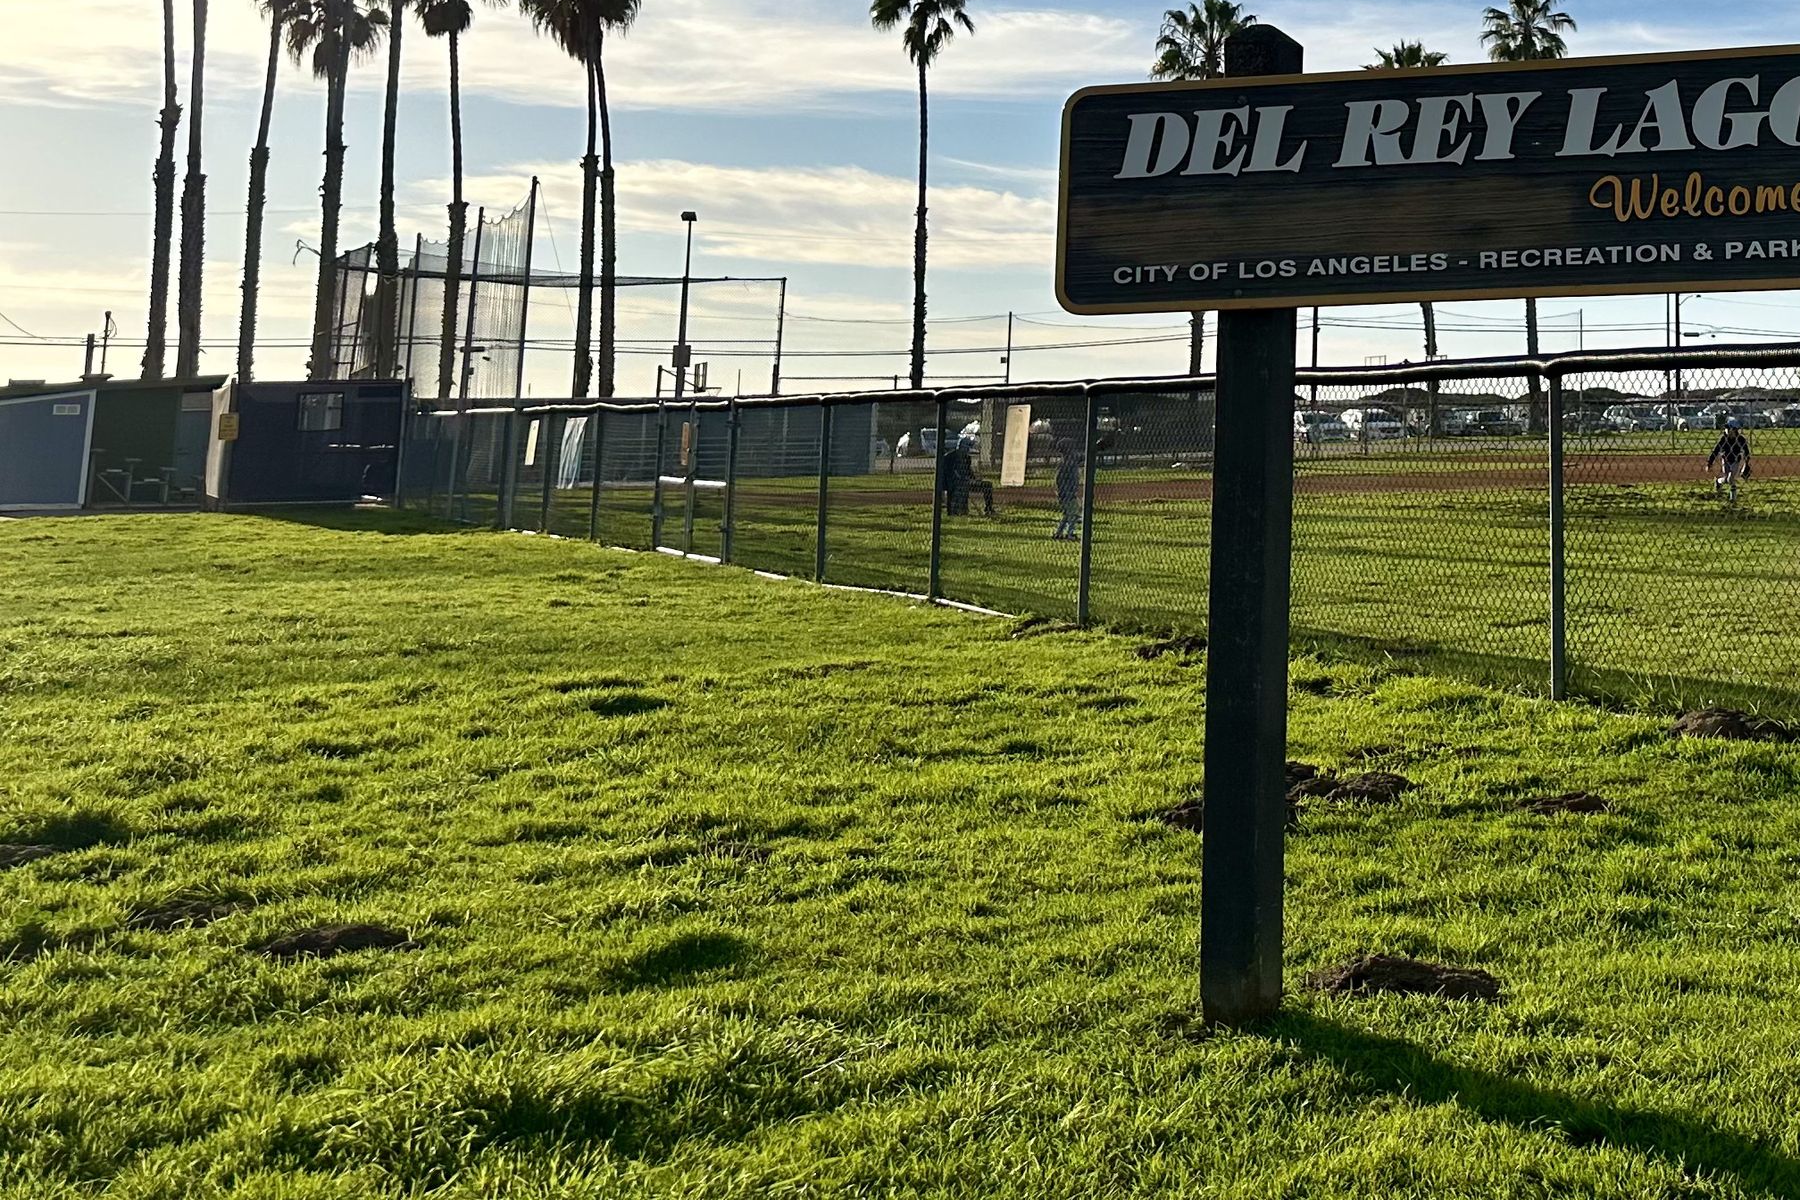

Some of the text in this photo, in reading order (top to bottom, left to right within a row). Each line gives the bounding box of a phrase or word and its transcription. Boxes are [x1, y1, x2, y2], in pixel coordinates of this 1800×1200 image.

[1113, 104, 1308, 179] DEL
[1331, 91, 1543, 168] REY
[1112, 264, 1179, 284] CITY
[1188, 262, 1229, 281] OF
[1238, 259, 1297, 279] LOS
[1306, 253, 1449, 276] ANGELES
[1479, 243, 1681, 269] RECREATION
[1692, 242, 1713, 261] &
